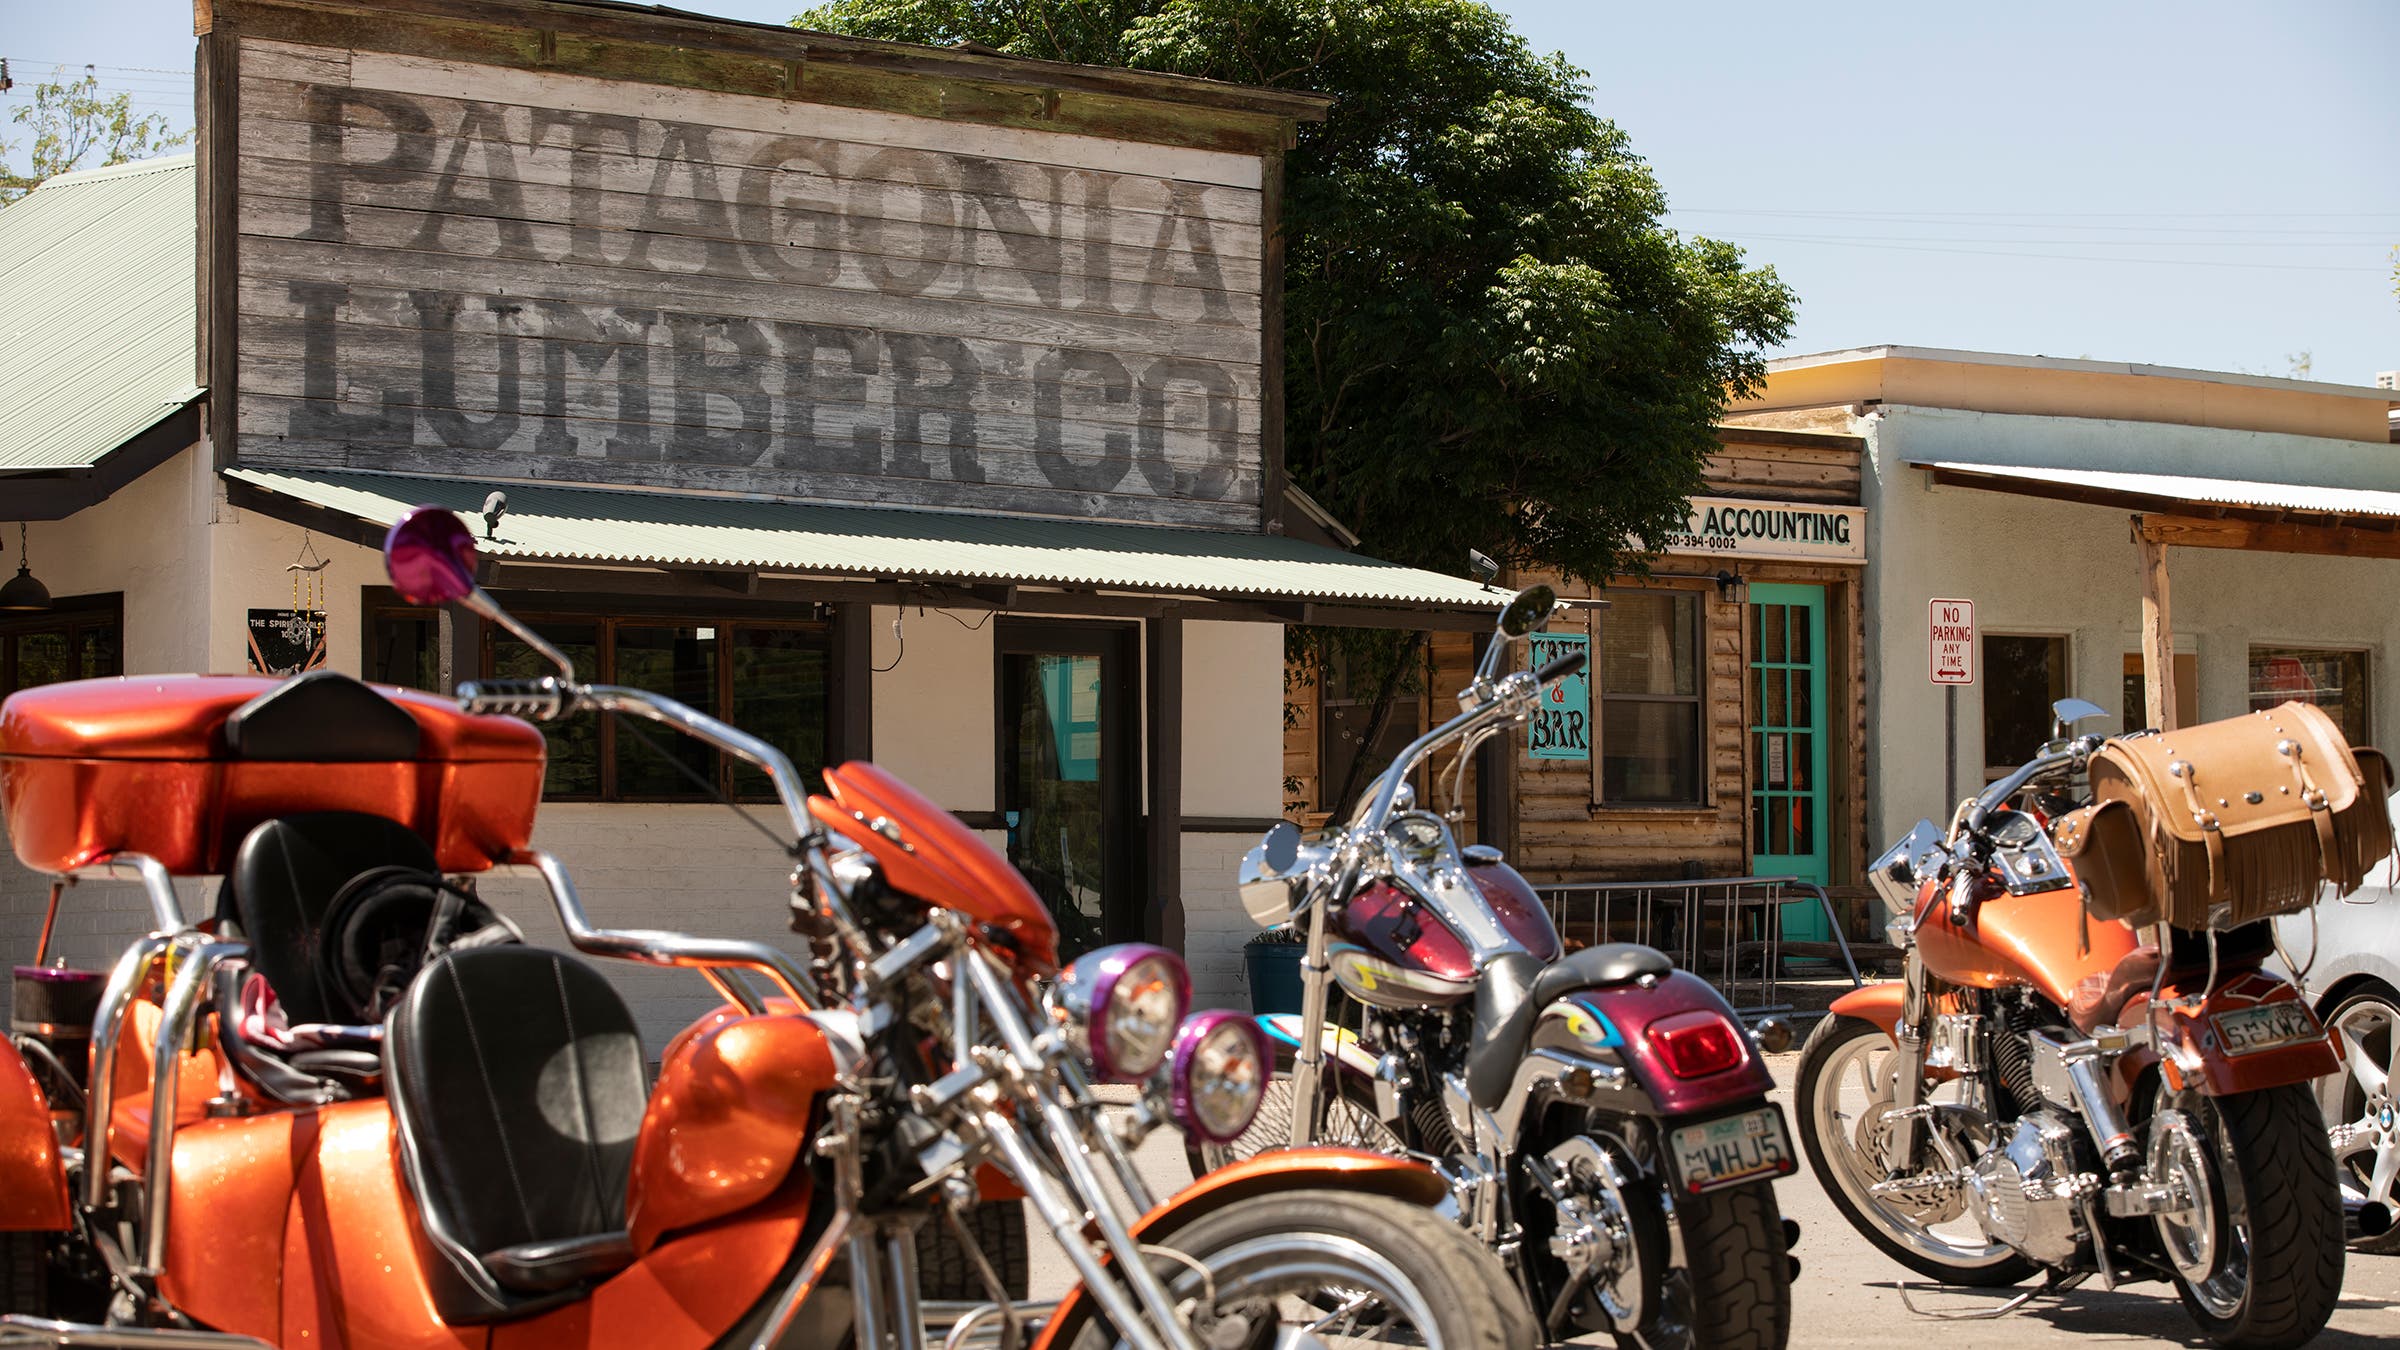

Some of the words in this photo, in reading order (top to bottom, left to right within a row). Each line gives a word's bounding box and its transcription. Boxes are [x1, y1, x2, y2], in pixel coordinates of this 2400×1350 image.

[293, 85, 1245, 327] PATAGONIA
[289, 280, 986, 484] LUMBER
[1703, 506, 1850, 544] ACCOUNTING
[1665, 534, 1737, 549] 20-394-0002
[250, 619, 266, 628] THE
[1943, 607, 1960, 623] NO
[1932, 625, 1971, 642] PARKING
[1943, 643, 1961, 654] ANY
[1942, 655, 1962, 667] TIME
[1551, 682, 1565, 703] &
[1529, 708, 1588, 751] BAR
